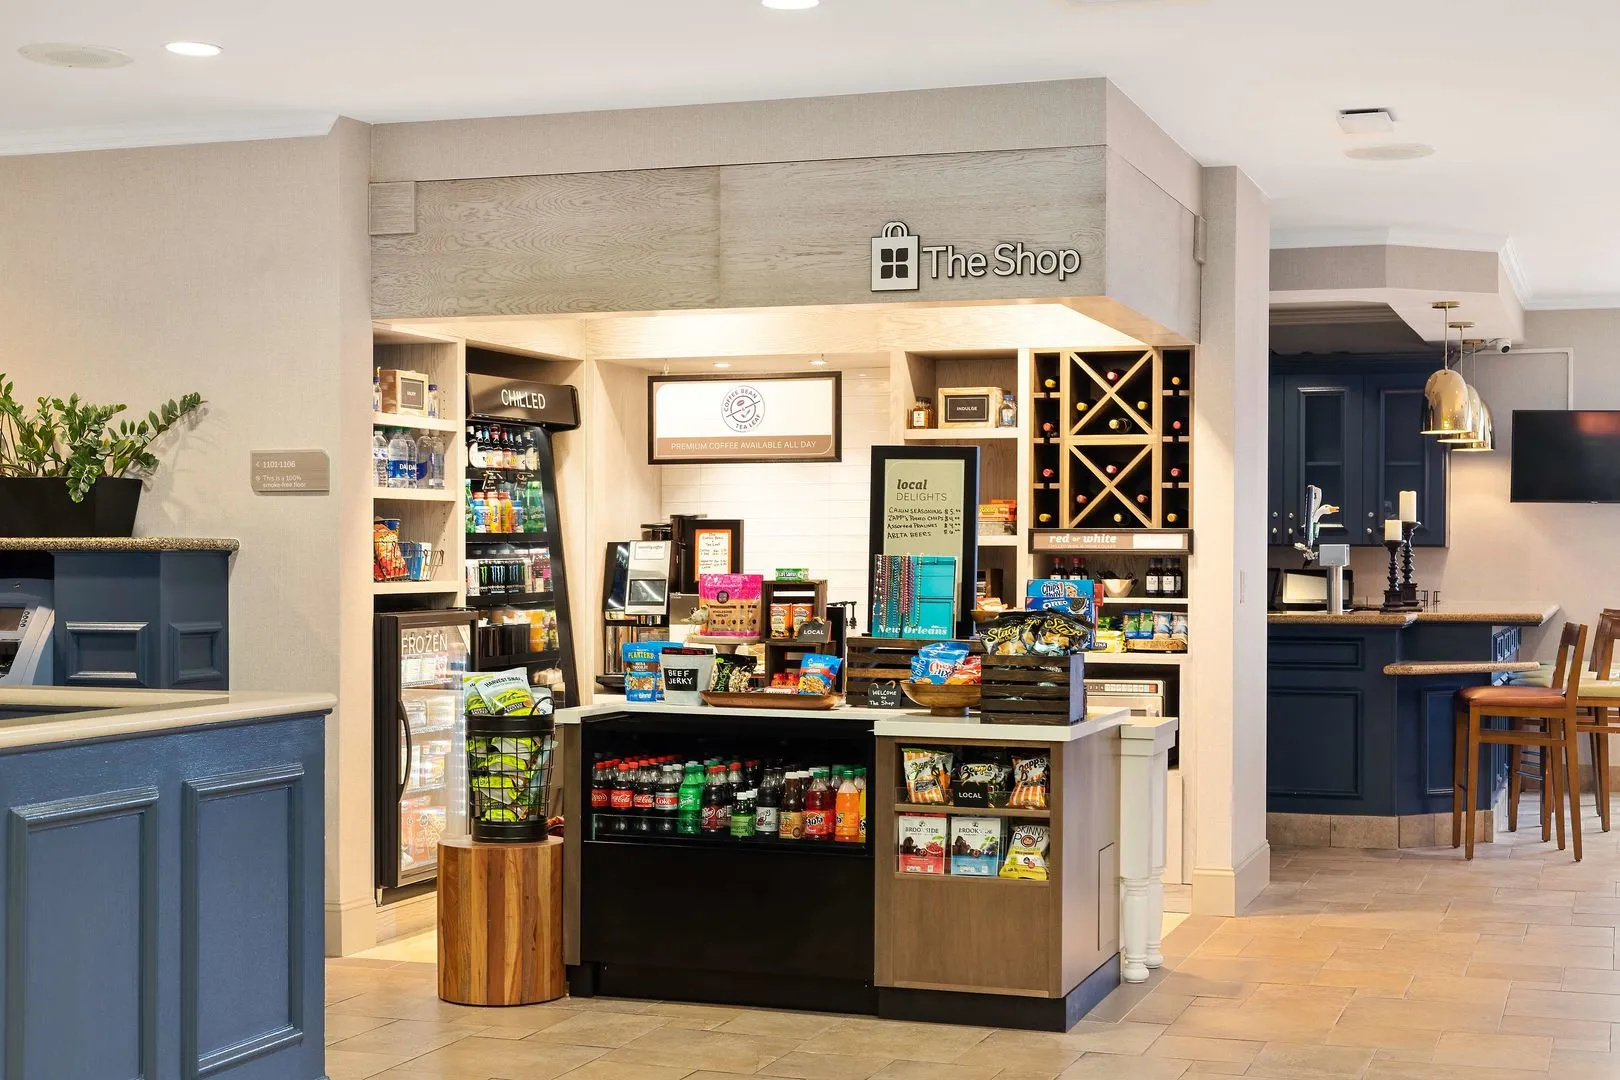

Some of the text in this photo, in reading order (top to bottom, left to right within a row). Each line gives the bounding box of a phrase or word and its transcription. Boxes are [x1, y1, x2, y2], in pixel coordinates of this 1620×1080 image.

[922, 242, 1082, 282] The Shop
[501, 388, 546, 411] CHILLED
[723, 388, 758, 412] COFFEE BEAN
[735, 414, 762, 430] TEA LEAF
[671, 440, 817, 450] PREMIUM COFFEE AVAILABLE ALL DAY
[896, 479, 928, 490] local
[896, 492, 947, 501] DELIGHTS
[1049, 533, 1070, 543] red
[1083, 533, 1117, 543] white
[878, 625, 948, 635] New Orleans
[401, 633, 448, 655] FROZEN
[668, 669, 690, 677] BEEF
[668, 677, 693, 685] JERKY
[958, 791, 983, 799] LOCAL
[656, 797, 673, 805] Coke
[1017, 825, 1048, 837] SKINNY
